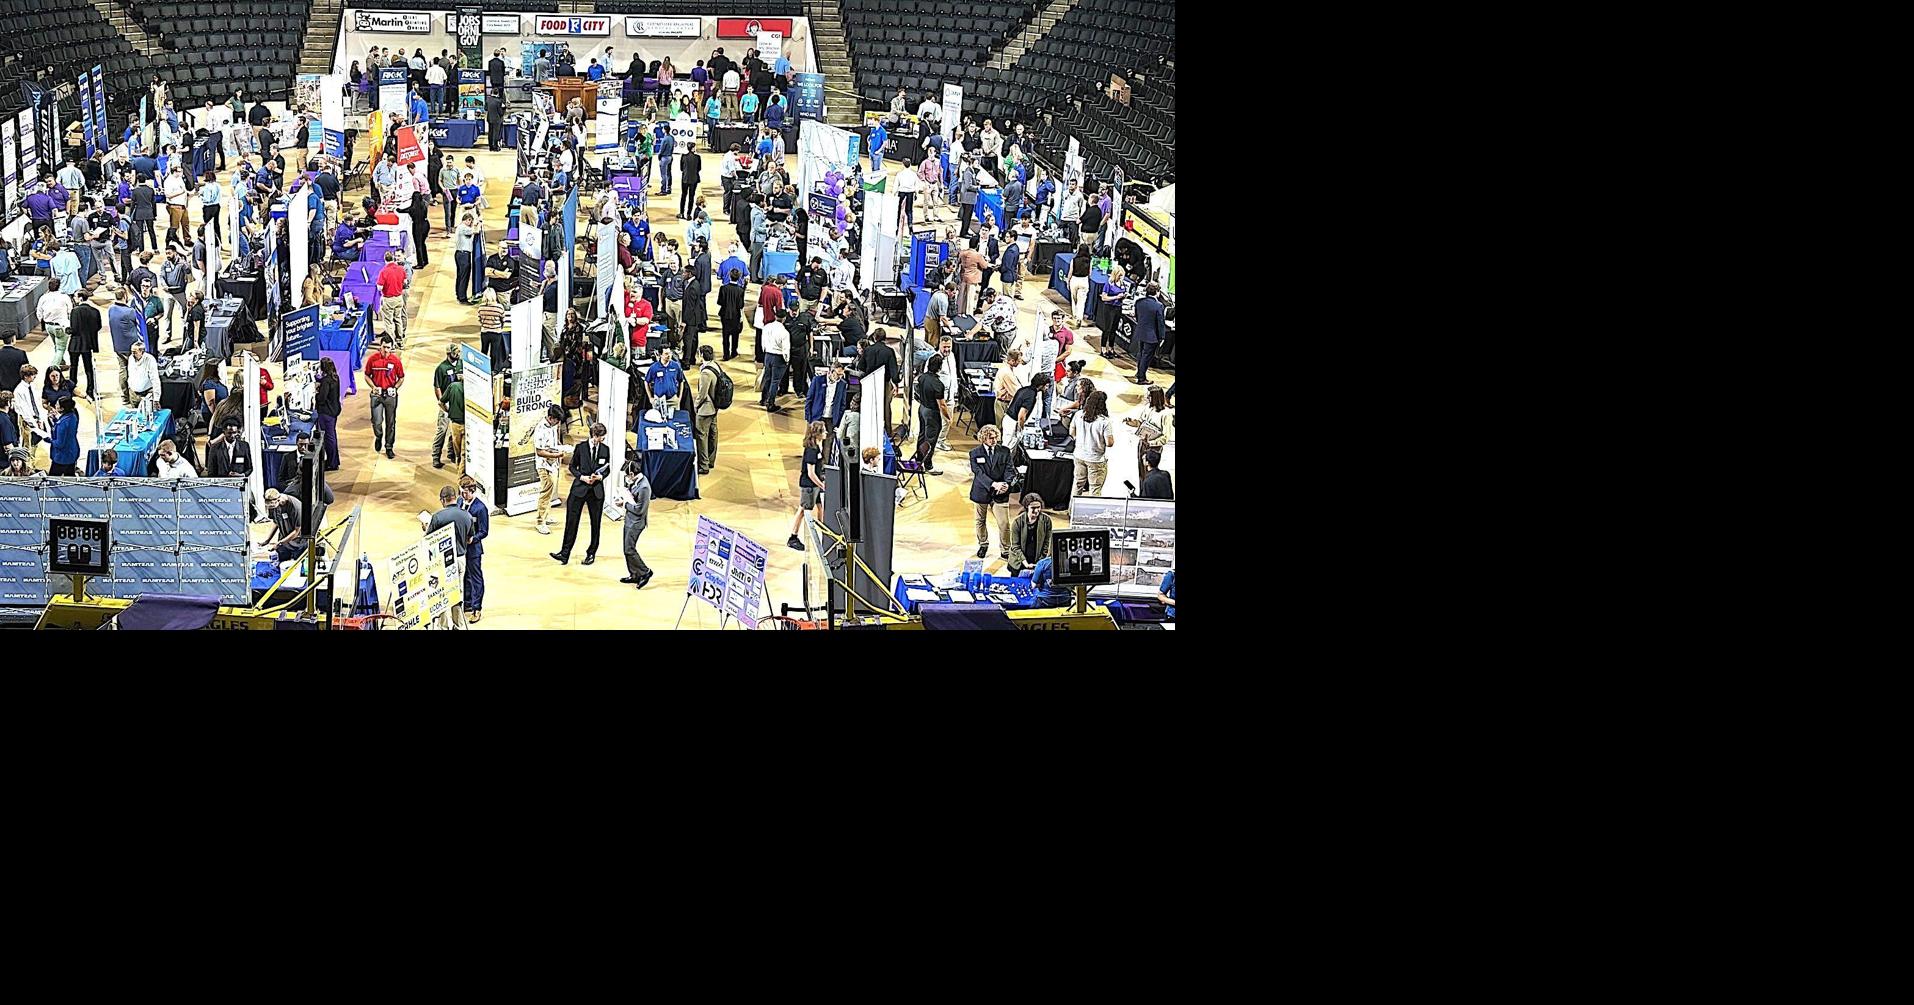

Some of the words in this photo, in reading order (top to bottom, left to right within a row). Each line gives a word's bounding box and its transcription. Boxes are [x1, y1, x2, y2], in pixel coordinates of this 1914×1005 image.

[371, 16, 403, 27] Martin
[458, 14, 481, 26] JOBS
[540, 20, 566, 31] FOOD
[583, 20, 605, 31] CITY
[457, 25, 482, 36] ORNL
[460, 35, 479, 46] GOV
[382, 71, 403, 79] RK&K
[461, 70, 481, 79] RK&K
[429, 128, 448, 137] K&K
[285, 315, 310, 328] Supporting
[286, 326, 297, 336] your
[296, 320, 314, 333] brighter
[288, 357, 301, 368] JMT
[516, 394, 541, 406] BUILD
[516, 400, 552, 414] STRONG
[704, 571, 726, 588] Clayton
